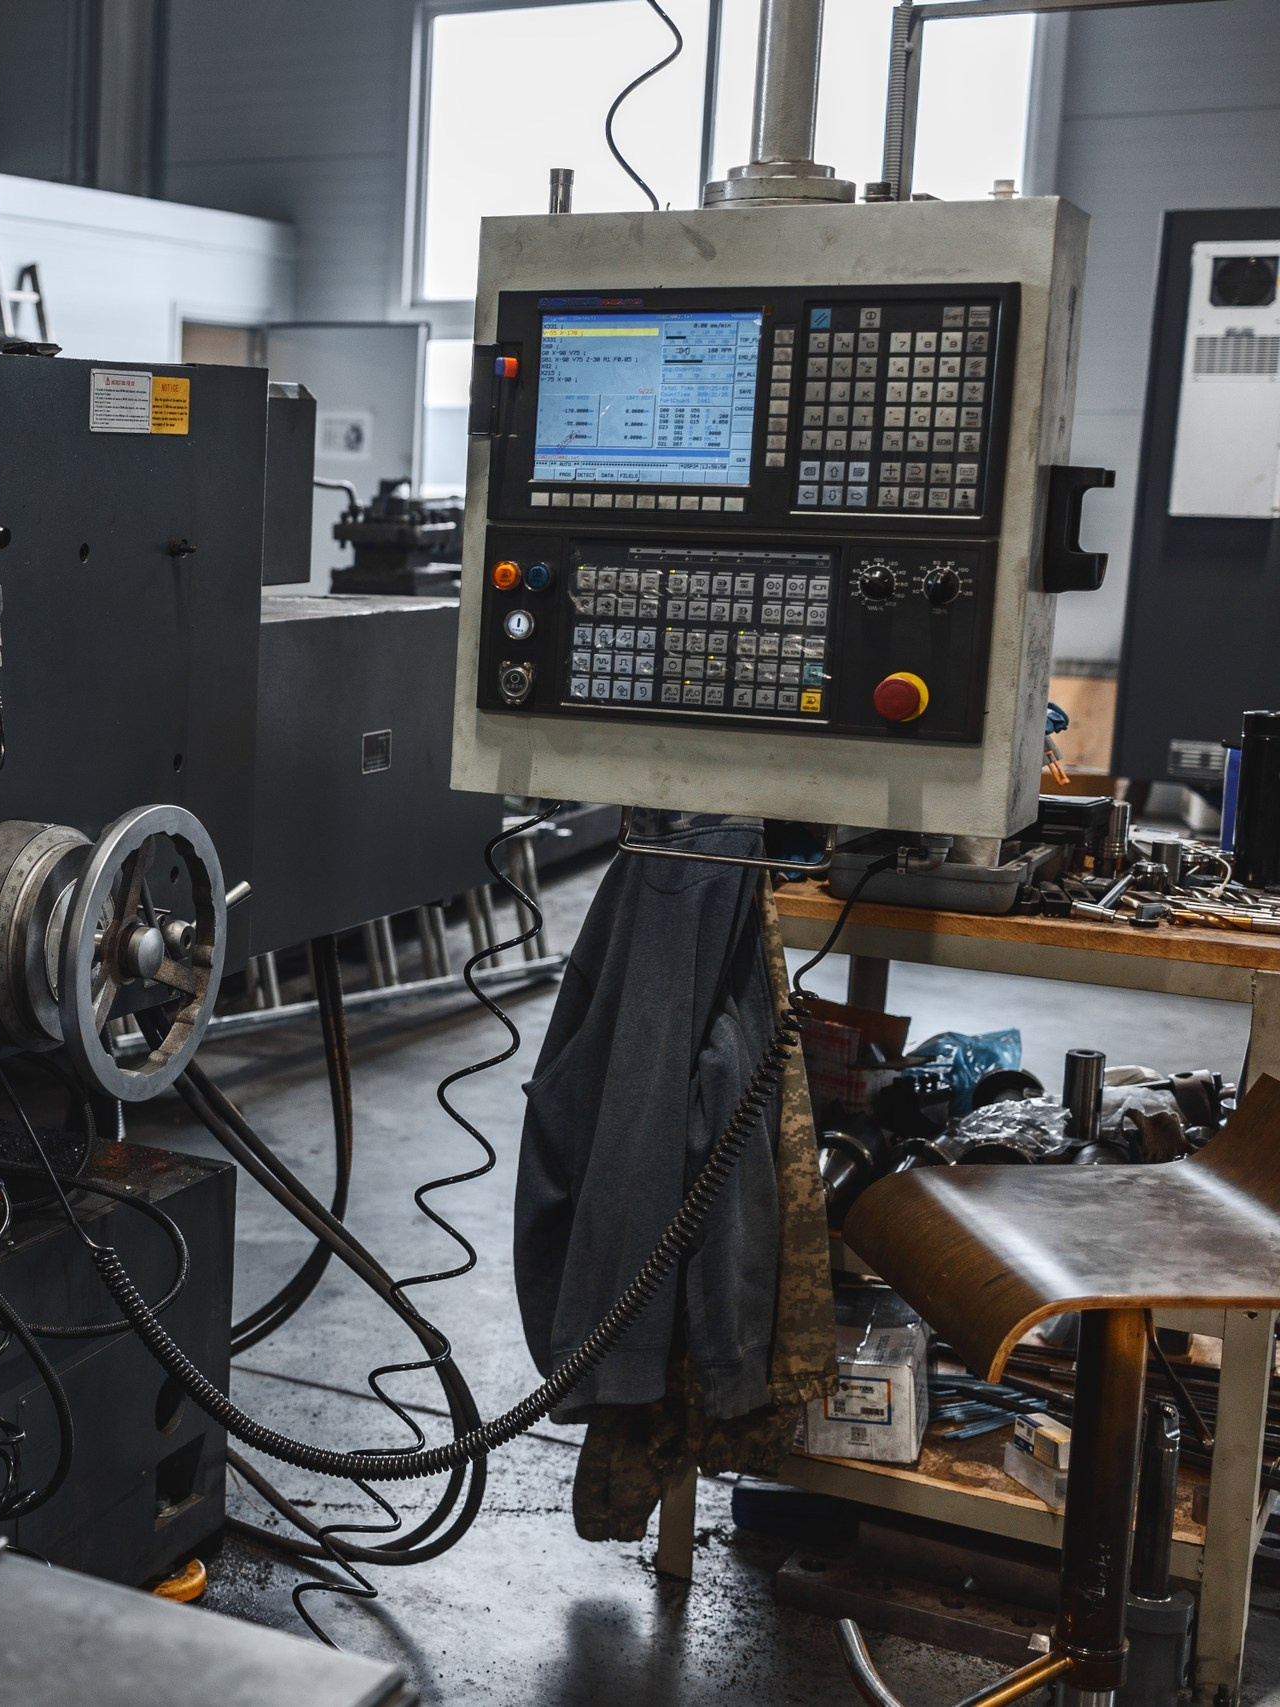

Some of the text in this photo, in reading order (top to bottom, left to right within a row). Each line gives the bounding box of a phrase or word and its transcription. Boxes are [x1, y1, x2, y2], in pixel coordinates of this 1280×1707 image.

[949, 340, 958, 348] 9
[922, 365, 930, 373] 5
[948, 365, 956, 373] 6
[161, 384, 179, 392] NOTICE
[862, 390, 871, 398] K
[920, 390, 928, 398] 2
[945, 390, 954, 398] 3
[890, 439, 899, 447] R
